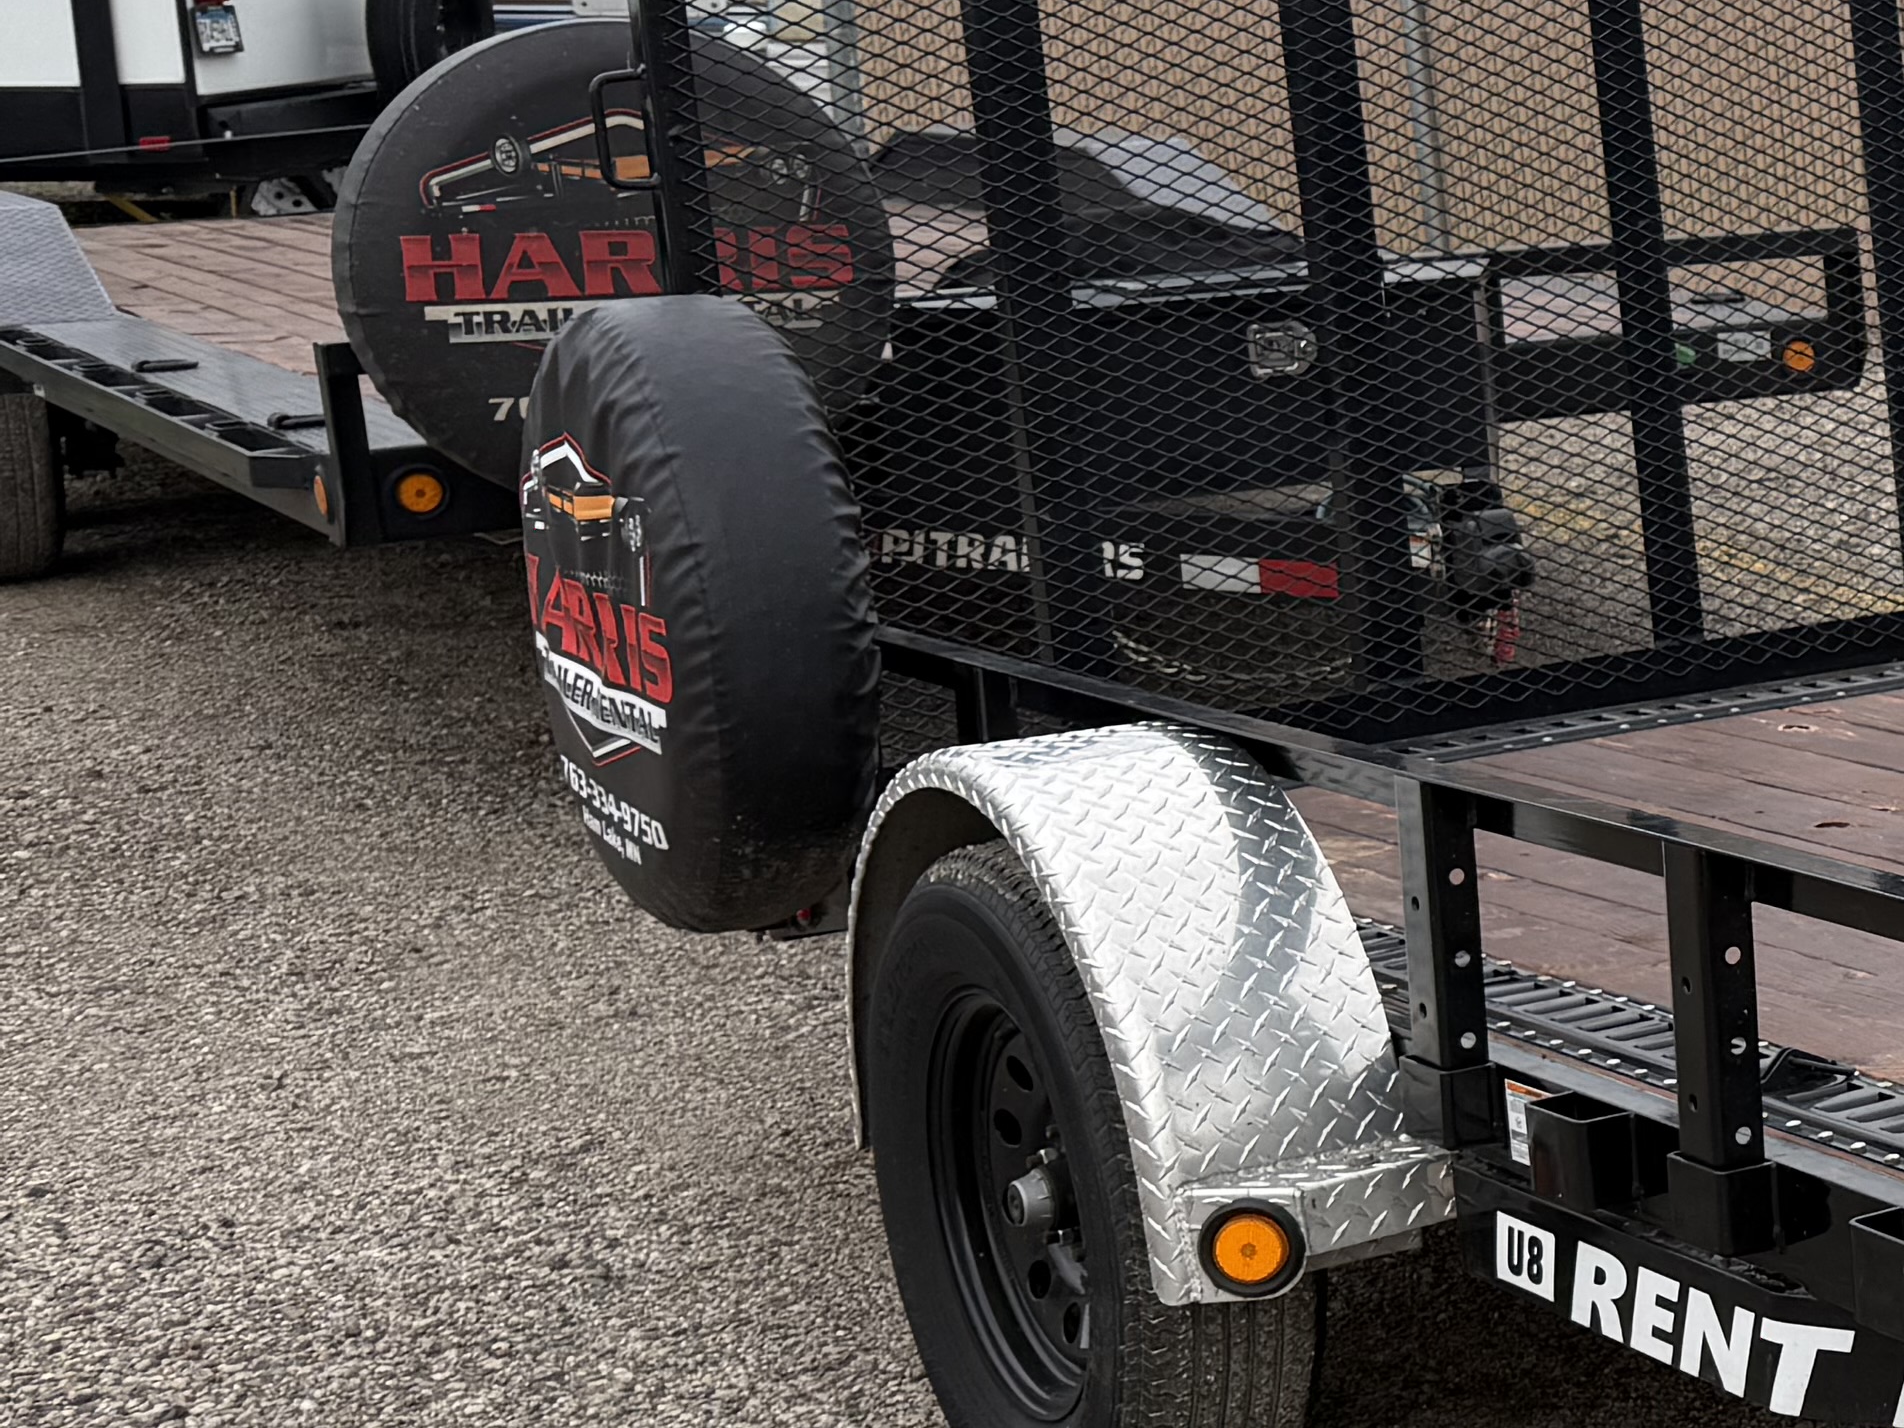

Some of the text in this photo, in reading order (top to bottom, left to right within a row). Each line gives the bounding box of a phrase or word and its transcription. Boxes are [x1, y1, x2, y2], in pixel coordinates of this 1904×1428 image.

[560, 755, 669, 850] 763-334-9750
[1507, 1225, 1543, 1287] U8
[1569, 1240, 1856, 1418] RENT
